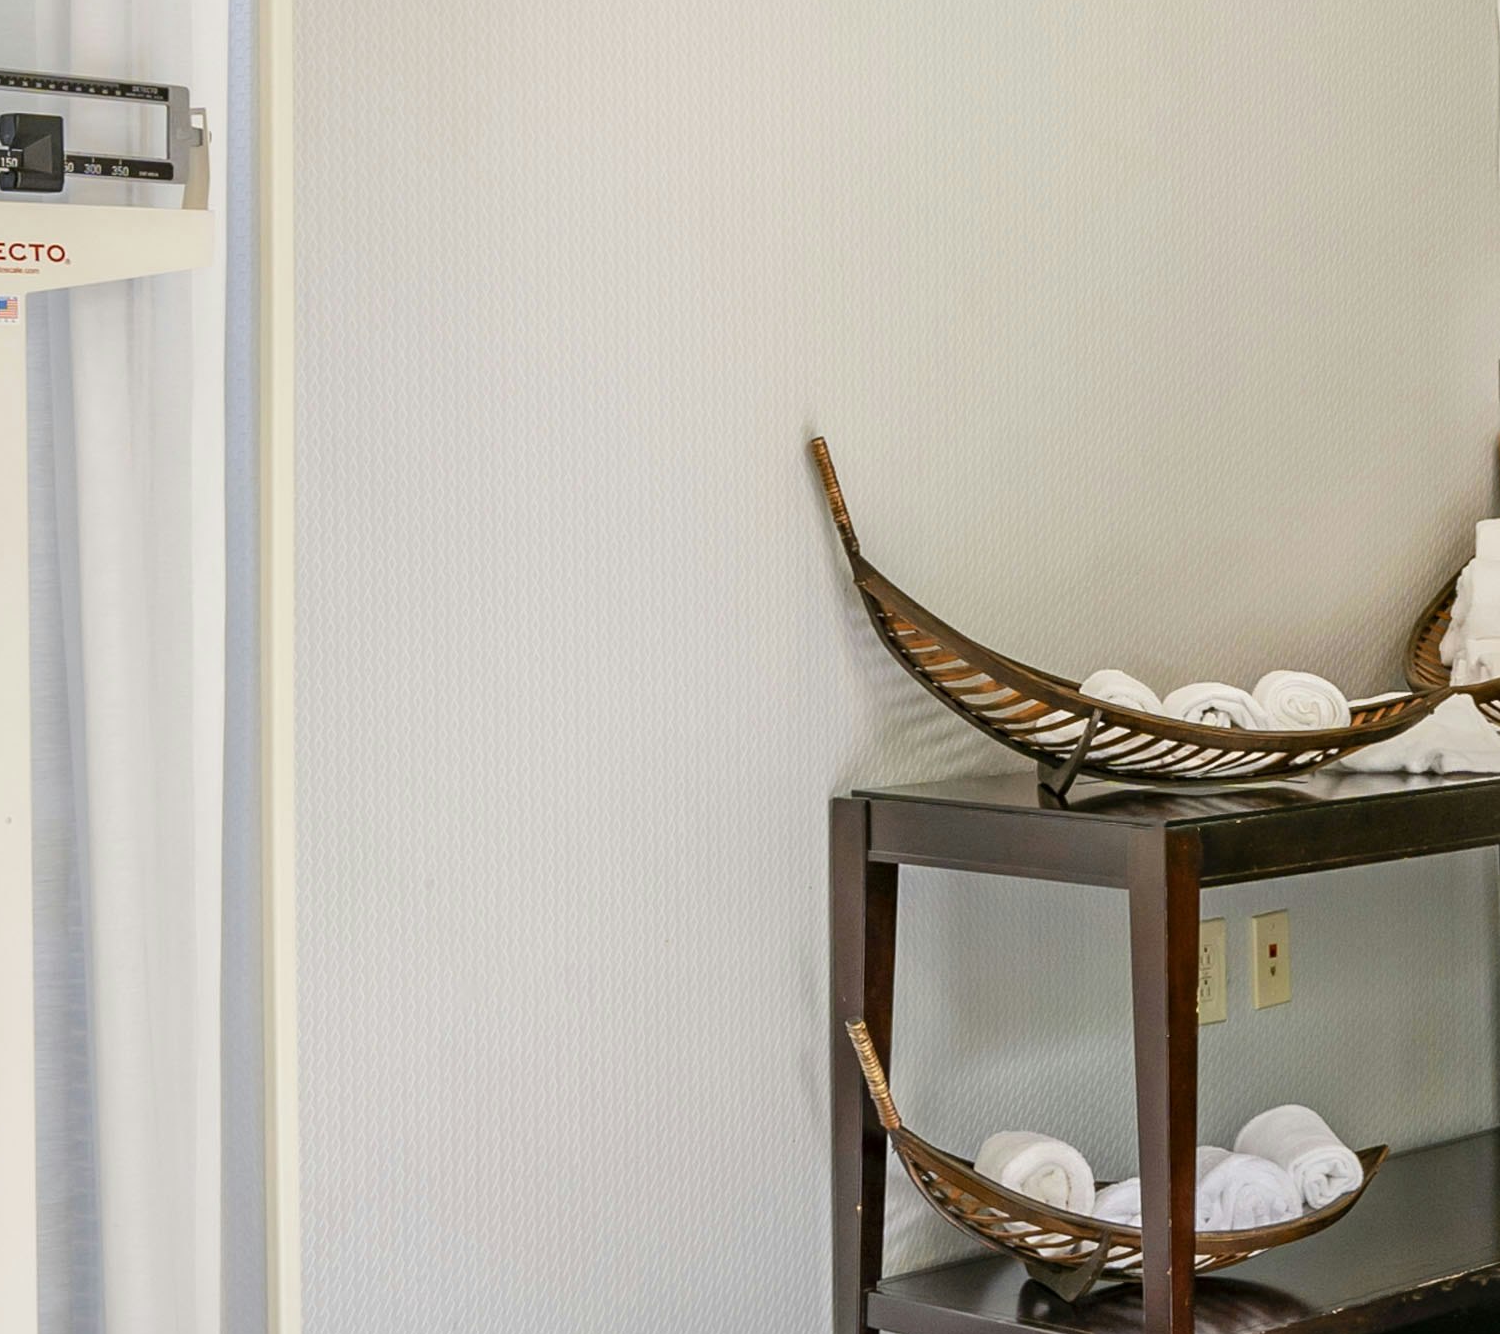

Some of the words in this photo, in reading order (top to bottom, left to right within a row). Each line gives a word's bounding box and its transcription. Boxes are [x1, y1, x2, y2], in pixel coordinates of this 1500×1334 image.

[0, 156, 18, 168] 150
[84, 163, 102, 175] 300
[111, 165, 130, 177] 350
